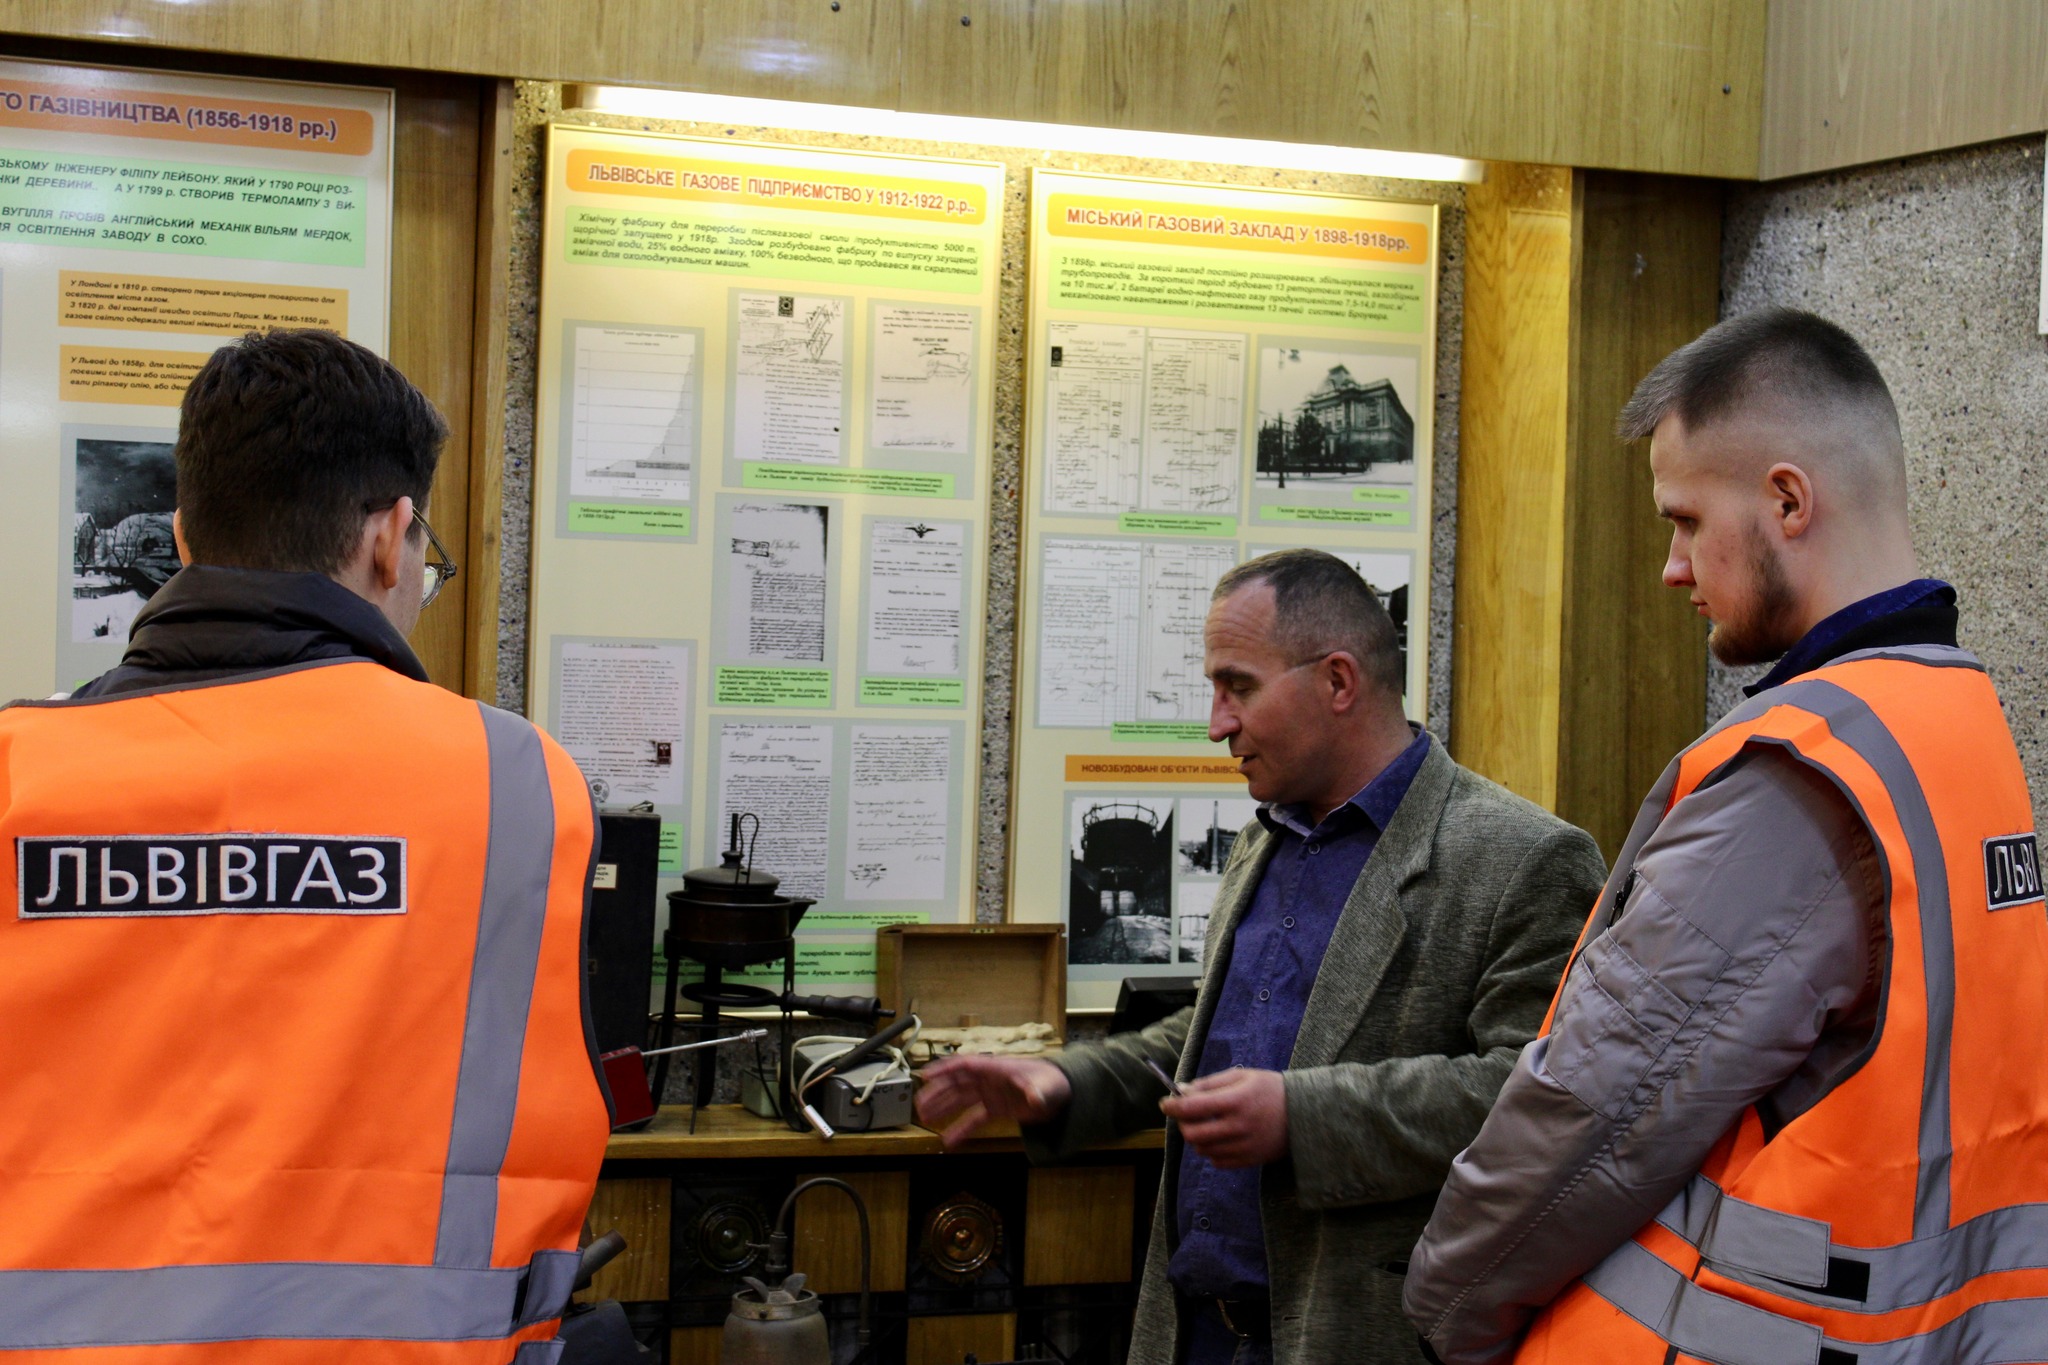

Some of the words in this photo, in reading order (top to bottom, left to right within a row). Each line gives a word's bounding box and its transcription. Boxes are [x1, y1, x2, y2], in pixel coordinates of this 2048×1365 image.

[54, 162, 118, 175] ІНЖЕНЕРУ
[118, 168, 160, 179] ФІЛІПУ
[160, 170, 221, 183] ЛЕЙБОНУ.
[222, 176, 256, 186] ЯКИЙ
[258, 178, 267, 187] У
[268, 179, 294, 190] 1790
[295, 181, 324, 193] РОЦІ
[325, 183, 352, 194] РОЗ-
[588, 165, 674, 185] ЛЬВІВСЬКЕ
[682, 172, 740, 191] ГАЗОВЕ
[747, 178, 862, 201] ПІДПРИЄМСТВО
[865, 188, 874, 203] У
[878, 190, 943, 209] 1912-1922
[16, 223, 96, 237] ОСВІТЛЕННЯ
[100, 229, 151, 242] ЗАВОДУ
[156, 233, 165, 242] В
[171, 234, 207, 245] СОХО.
[1066, 209, 1142, 226] МІСЬКИЙ
[1147, 215, 1224, 233] ГАЗОВИЙ
[1228, 222, 1295, 241] ЗАКЛАД
[1299, 227, 1308, 240] У
[1313, 229, 1411, 250] 1898-1918рр.
[1081, 764, 1158, 773] НОВОЗБУДОВАНІ
[1160, 764, 1199, 773] ОБ'ЄКТИ
[36, 845, 387, 907] ЛЬВІВГАЗ
[1994, 842, 2040, 899] ЛЬВІ
